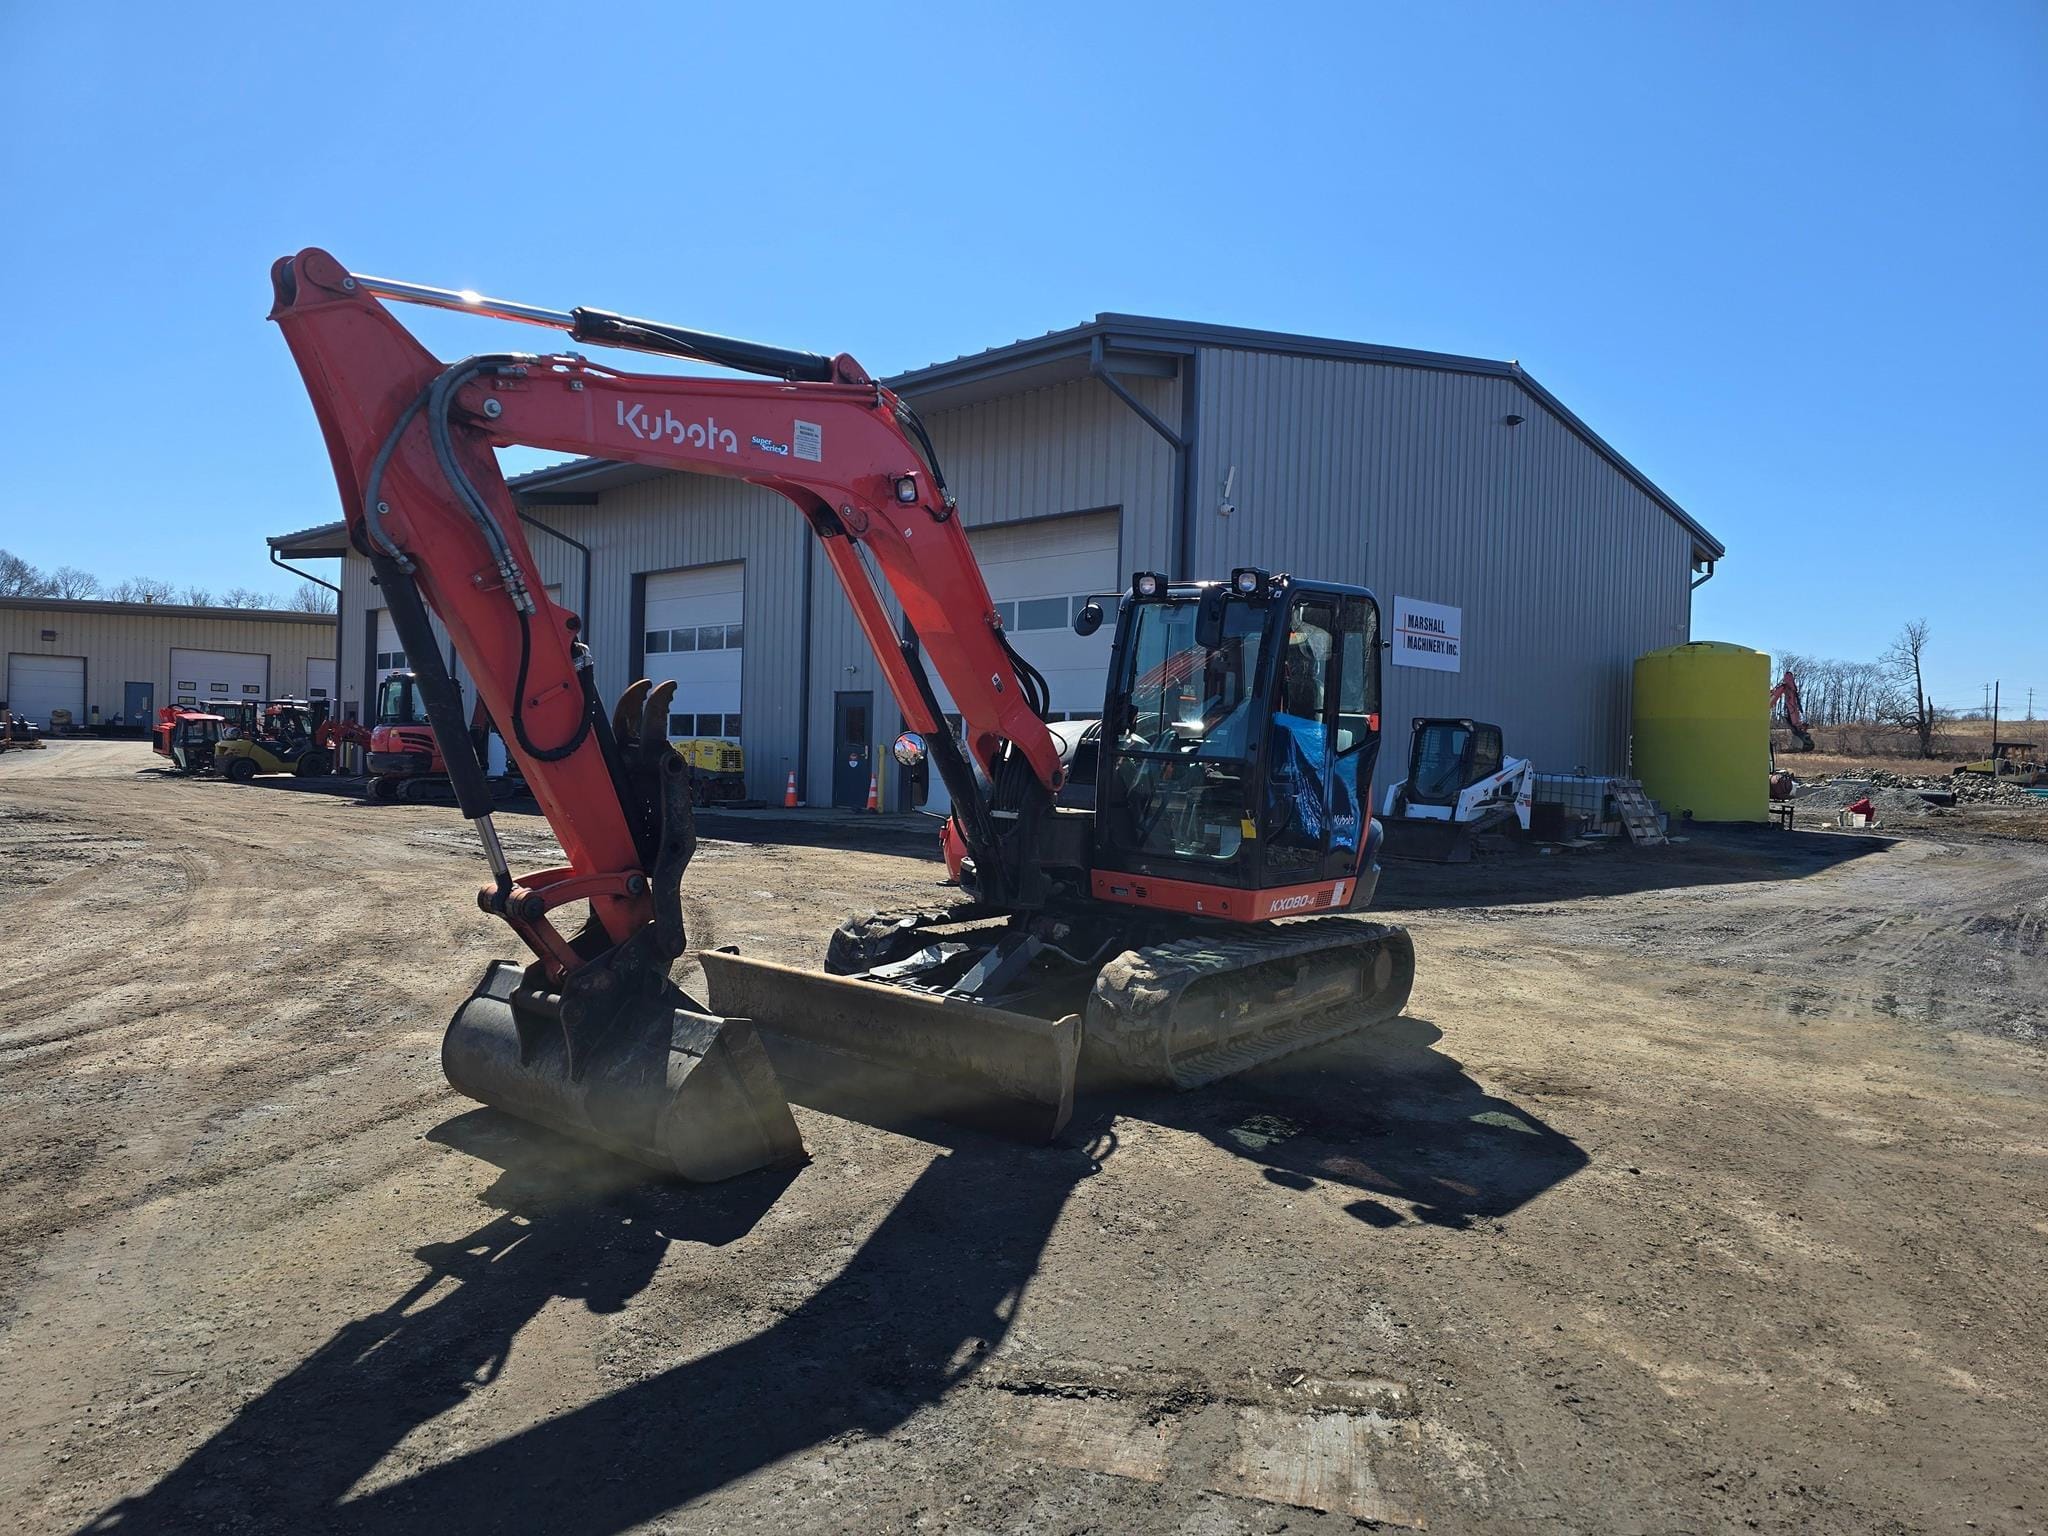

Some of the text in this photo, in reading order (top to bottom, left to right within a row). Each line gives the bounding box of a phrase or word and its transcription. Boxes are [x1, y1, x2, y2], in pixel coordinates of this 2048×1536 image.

[617, 400, 738, 453] Kubota
[751, 435, 772, 446] Super
[1408, 614, 1446, 633] MARSHALL
[1446, 641, 1459, 656] Inc.
